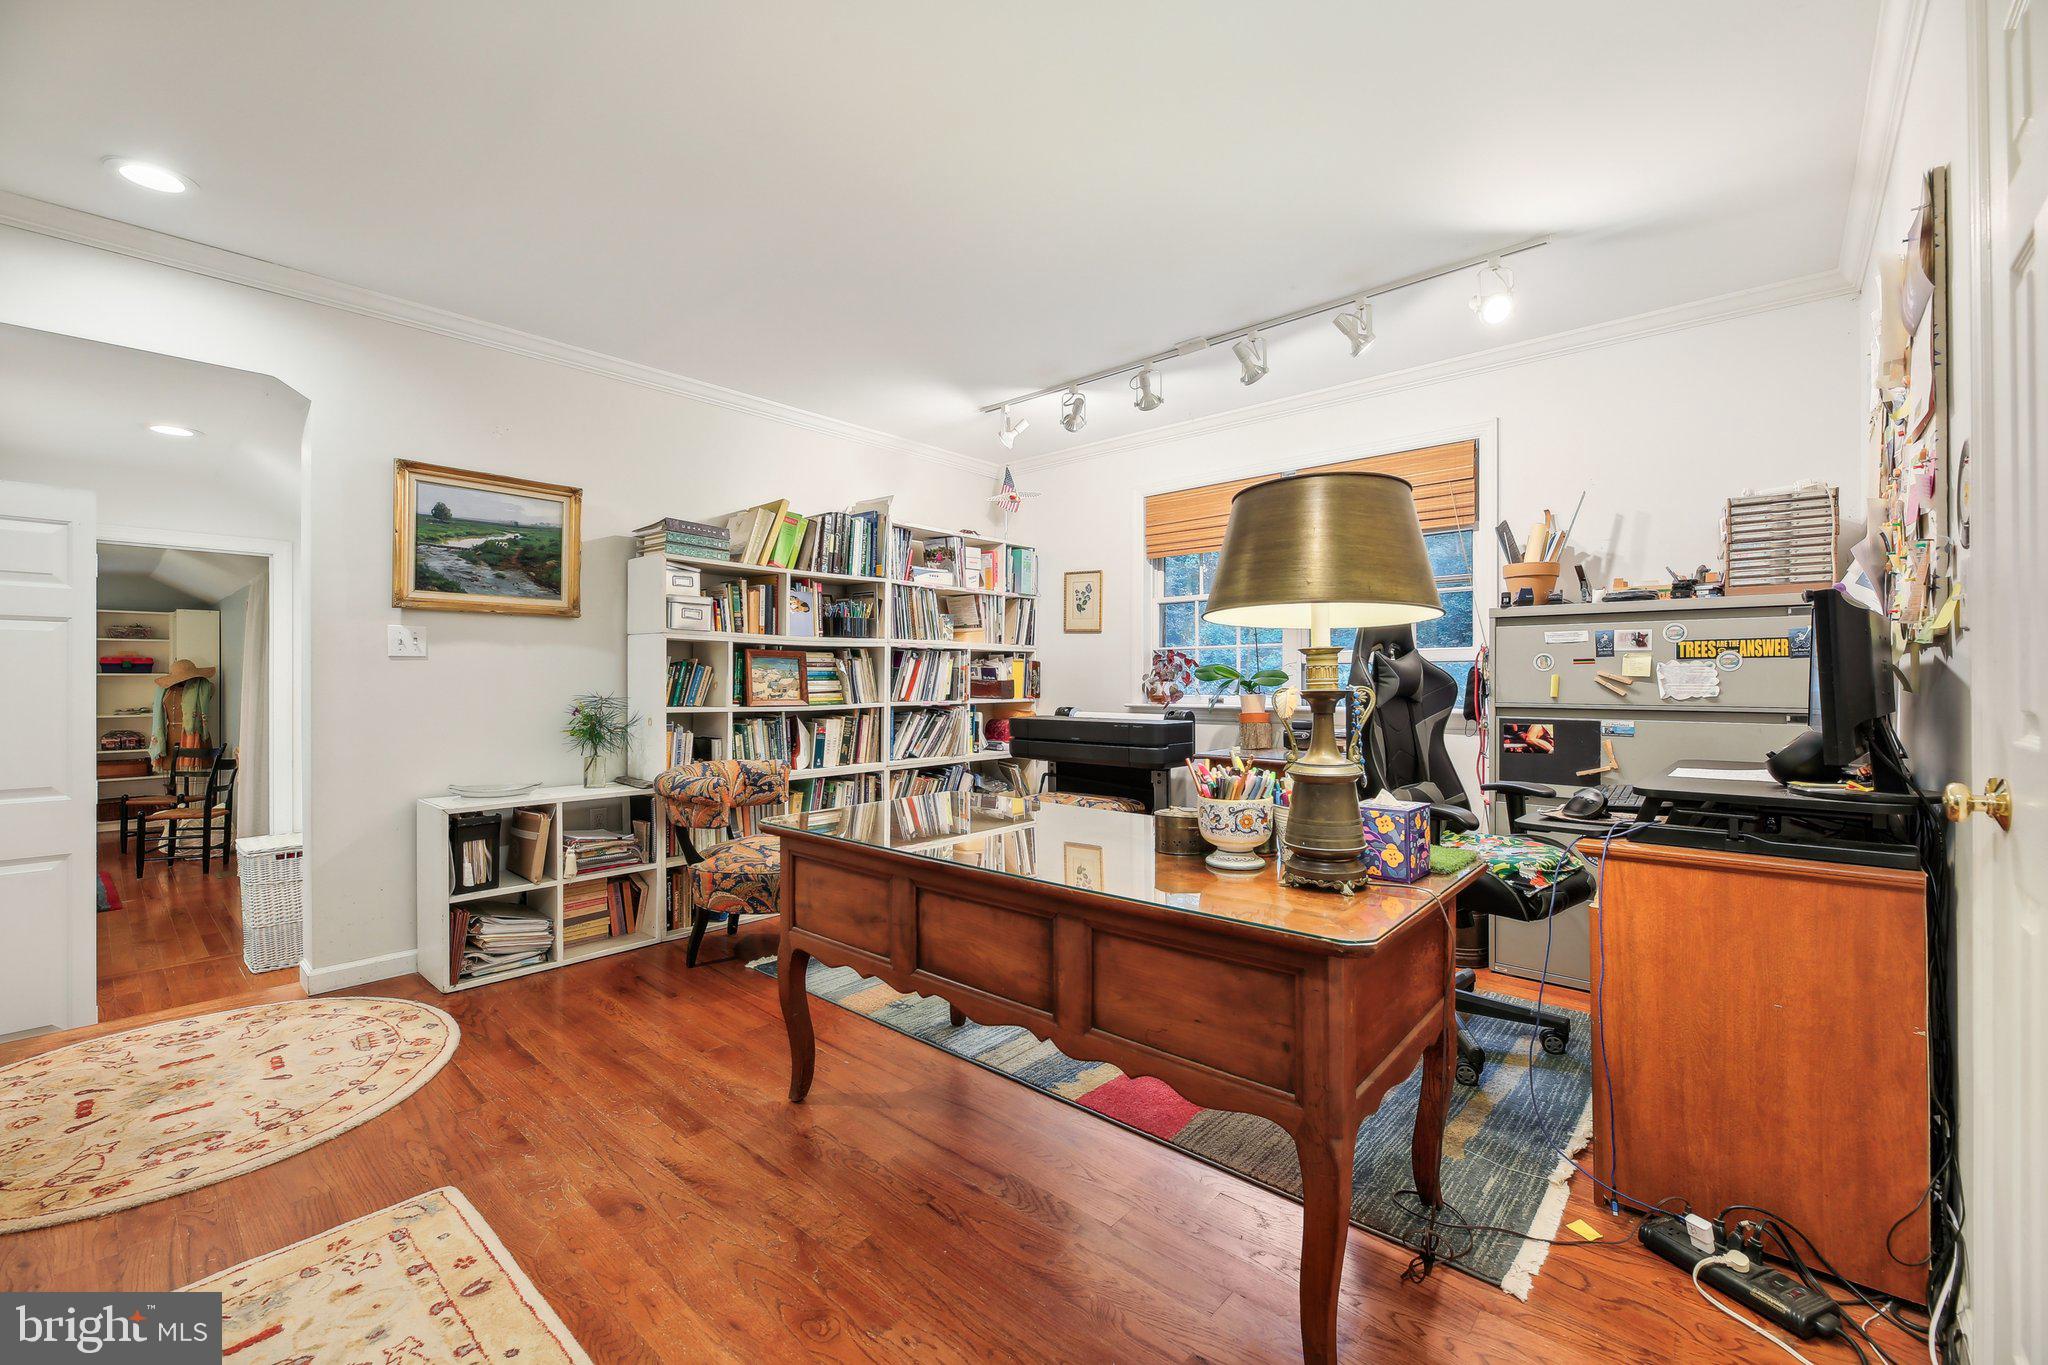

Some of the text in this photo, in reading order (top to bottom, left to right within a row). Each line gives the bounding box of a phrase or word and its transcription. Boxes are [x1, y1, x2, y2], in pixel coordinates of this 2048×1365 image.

[1678, 640, 1717, 658] TREES
[1717, 640, 1728, 648] ARE
[1739, 638, 1789, 657] ANSWER
